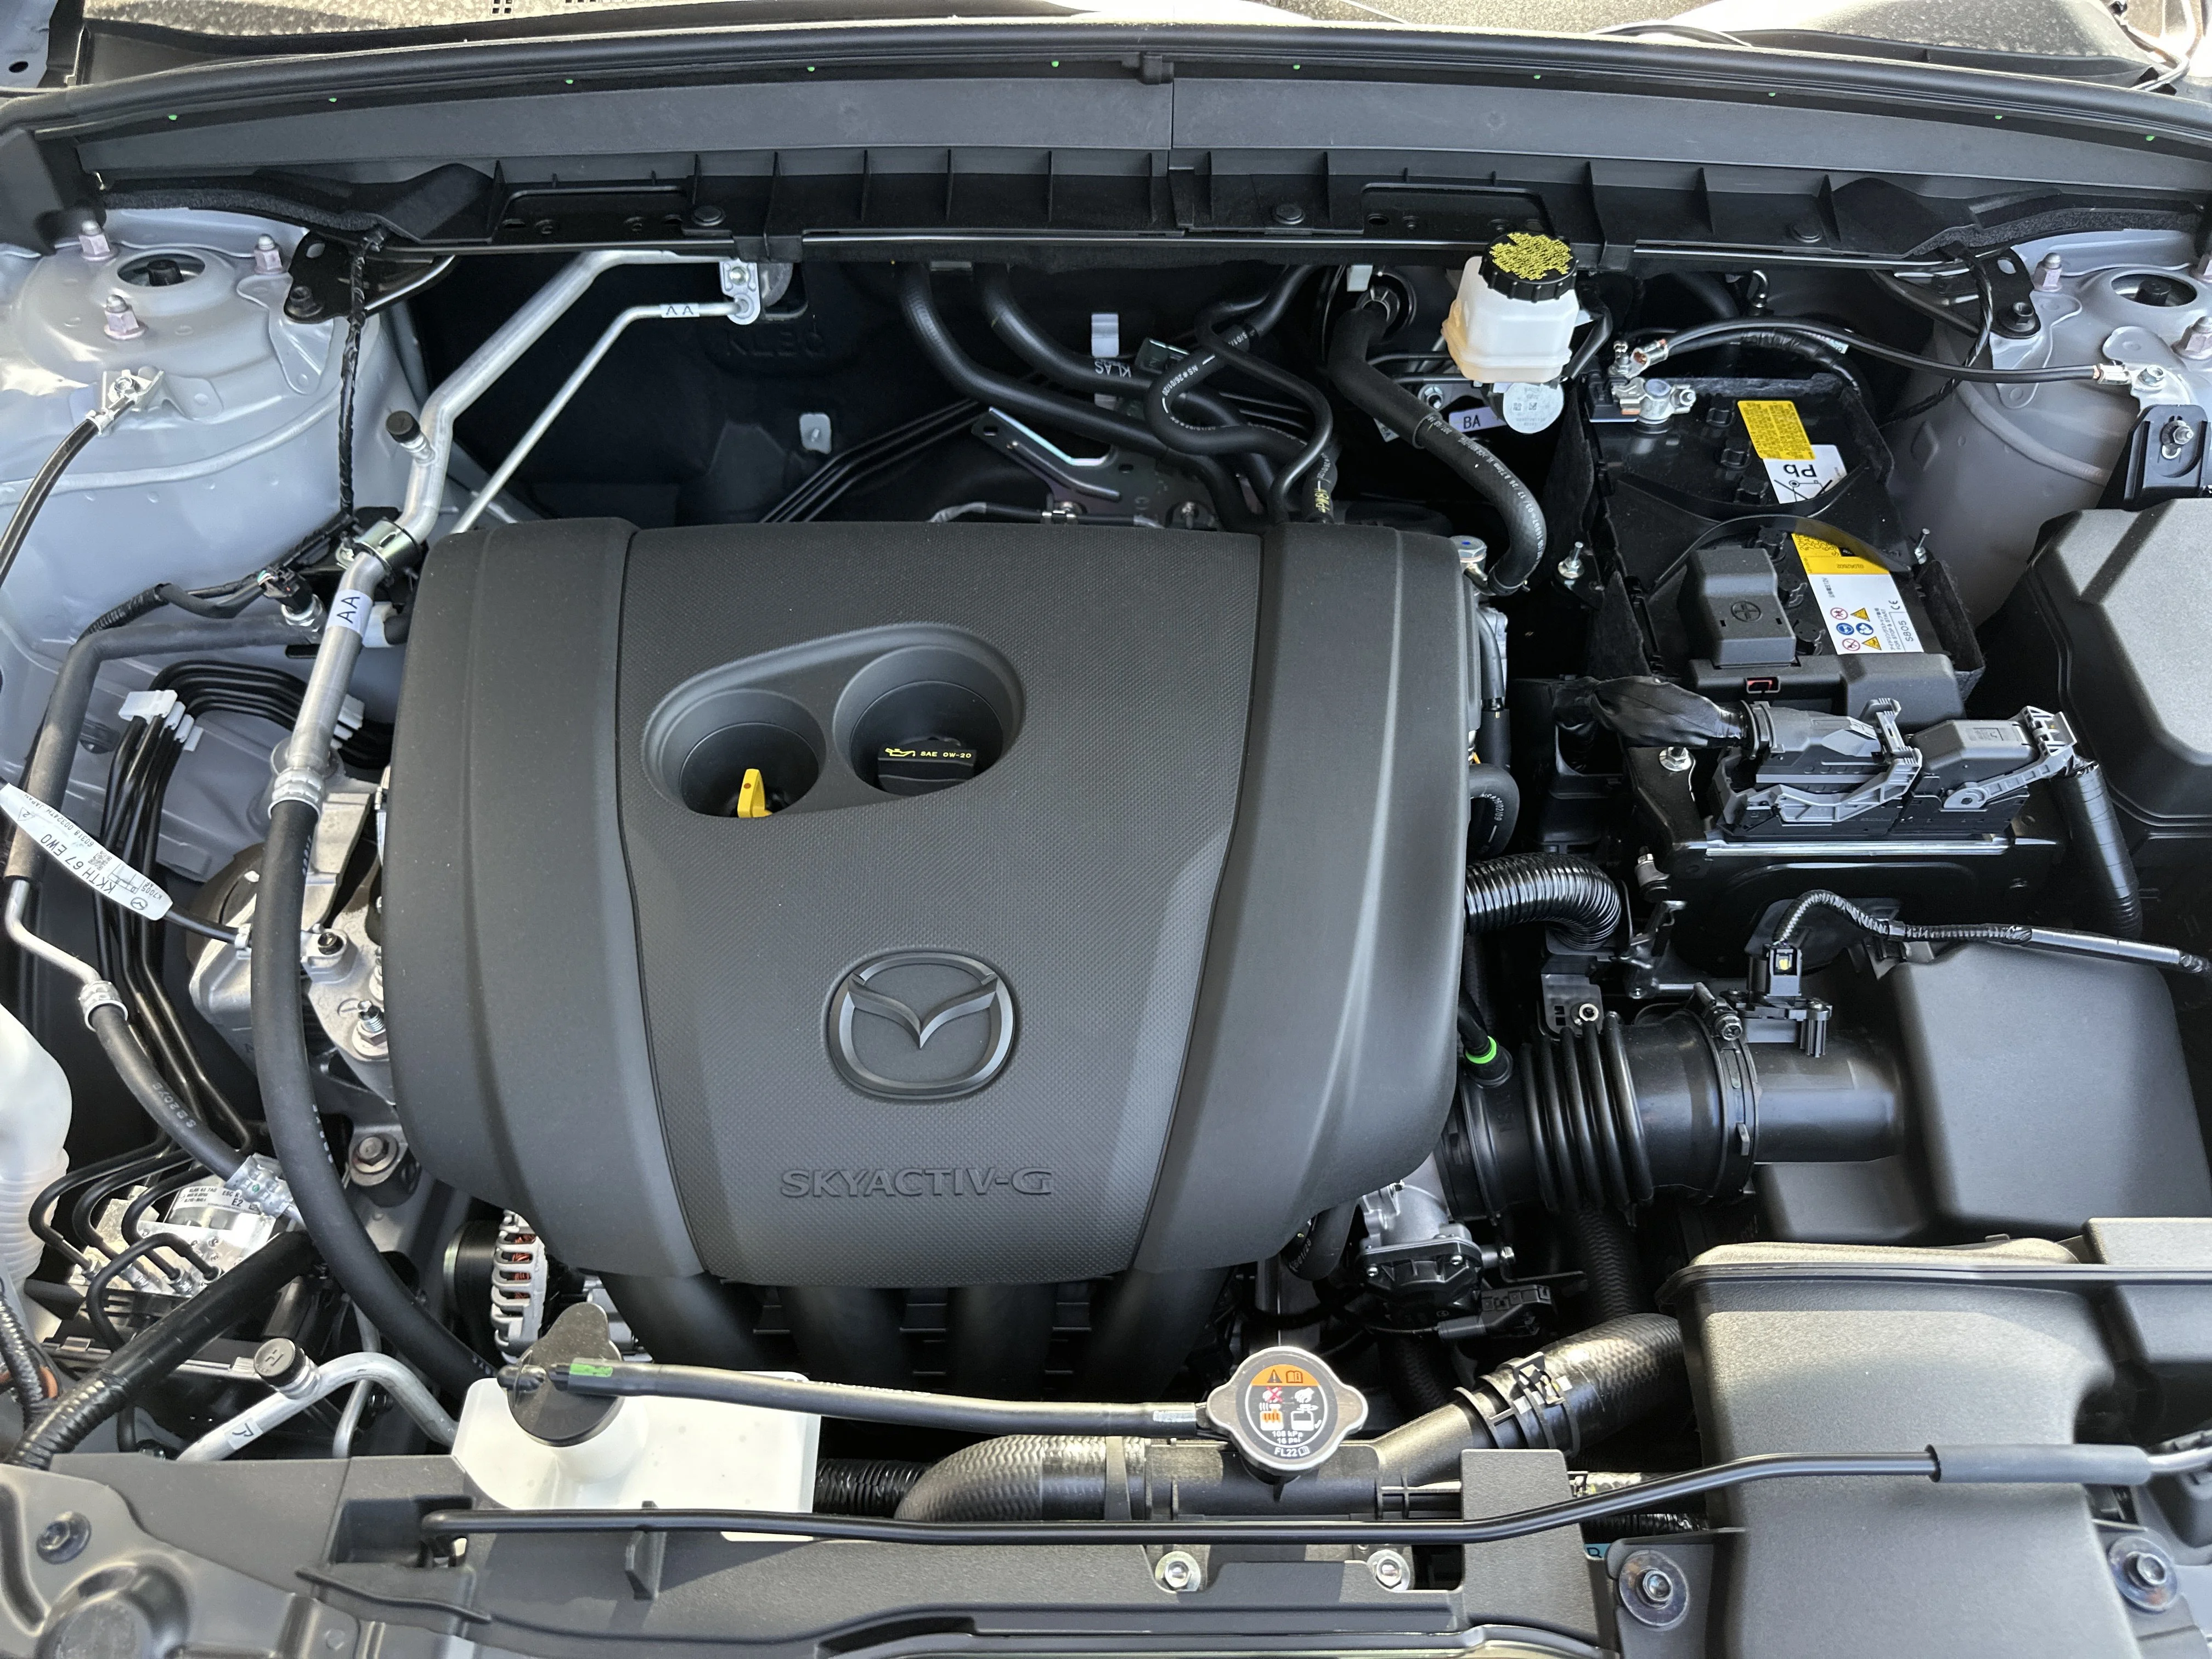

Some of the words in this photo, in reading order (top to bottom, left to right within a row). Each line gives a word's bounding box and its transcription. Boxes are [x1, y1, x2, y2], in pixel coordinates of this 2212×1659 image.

[1463, 415, 1481, 429] BA
[1783, 464, 1817, 478] Pb
[1888, 628, 1897, 639] STOP
[1897, 620, 1914, 641] S805
[24, 794, 46, 811] JAPAN
[75, 830, 94, 847] 60318
[65, 856, 84, 870] 67
[82, 868, 116, 894] KKTH
[780, 1167, 1054, 1198] SKYACTIV-G
[1274, 1447, 1297, 1457] FL22
